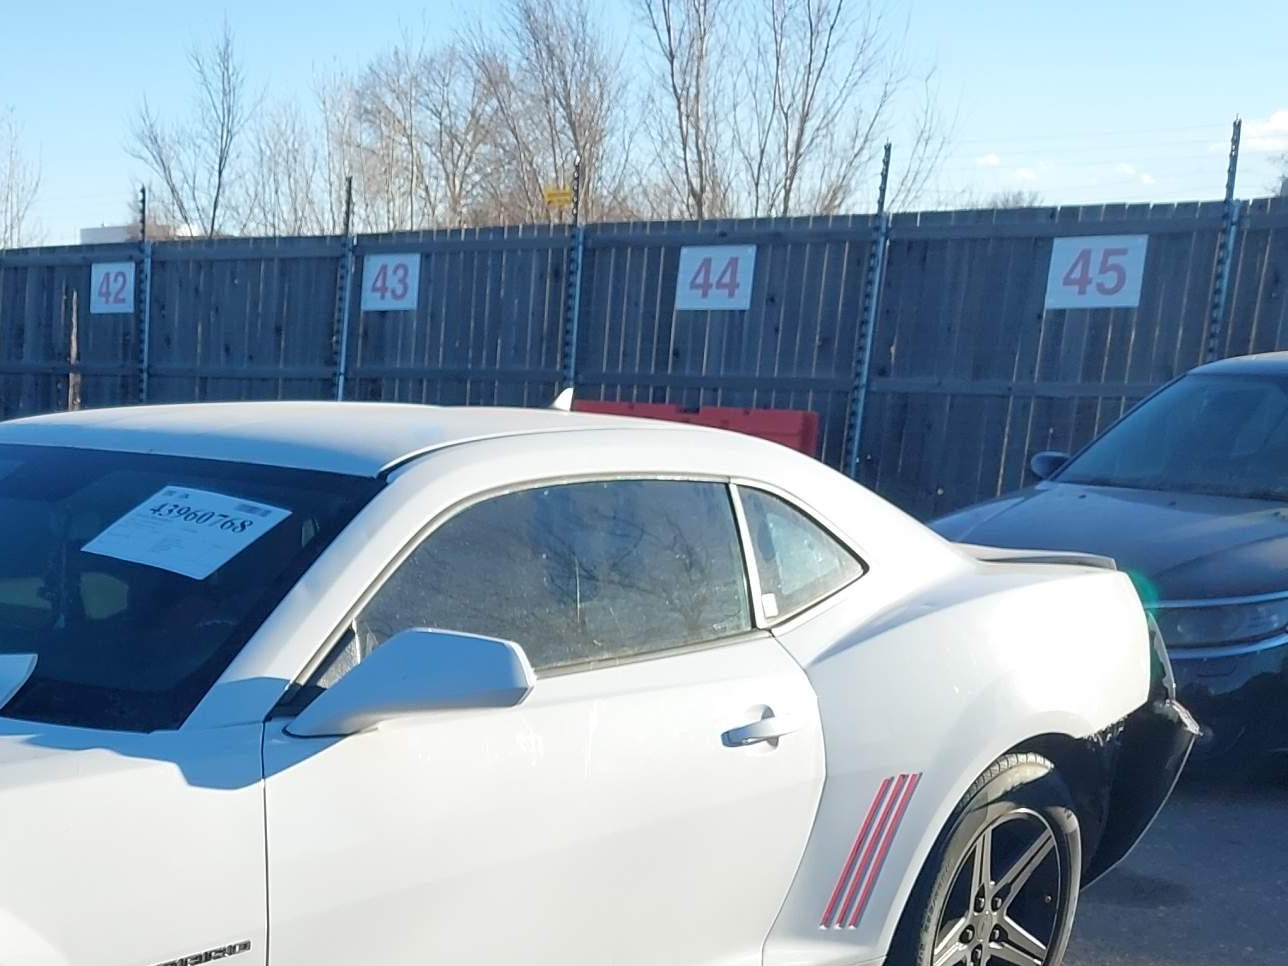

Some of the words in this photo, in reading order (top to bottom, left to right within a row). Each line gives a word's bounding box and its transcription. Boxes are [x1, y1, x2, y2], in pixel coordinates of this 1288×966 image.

[97, 271, 127, 304] 42
[371, 263, 409, 300] 43
[689, 256, 740, 298] 44
[1062, 248, 1129, 296] 45
[149, 502, 253, 534] 43960768
